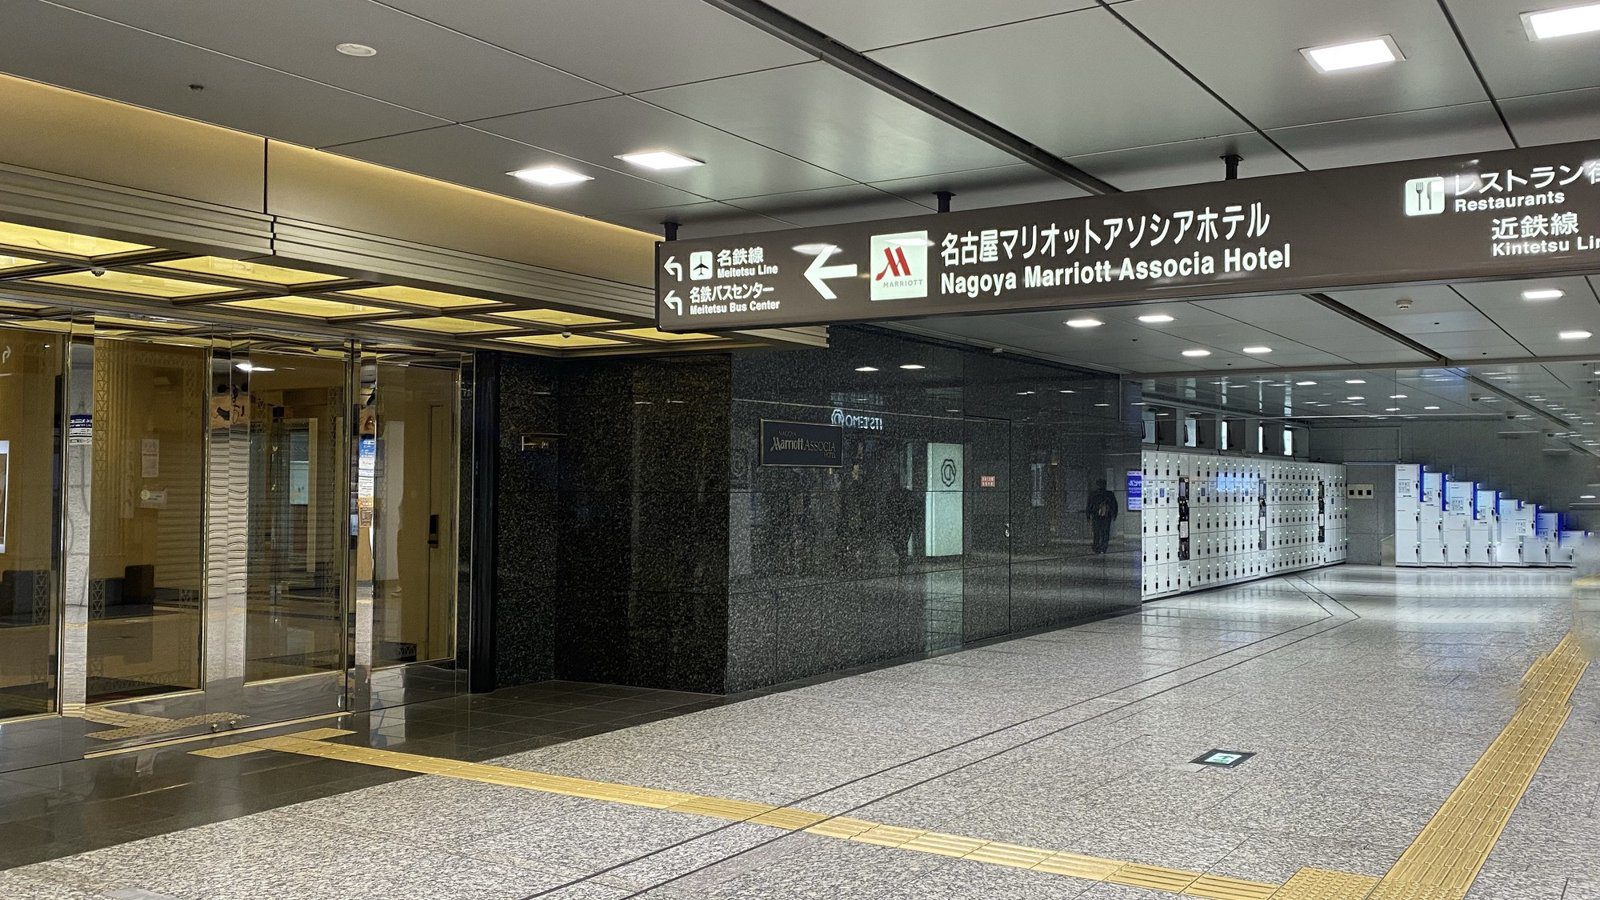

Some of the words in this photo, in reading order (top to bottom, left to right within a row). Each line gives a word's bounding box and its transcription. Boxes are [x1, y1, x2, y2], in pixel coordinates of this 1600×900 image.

[1454, 191, 1565, 213] Restaurants
[940, 202, 1270, 266] 名古屋マリオットアソシアホテル
[1491, 212, 1580, 241] 近鉄線
[717, 246, 764, 267] 名鉄線
[1492, 240, 1570, 257] Kintetsu
[717, 267, 756, 279] Meitetsu
[757, 264, 779, 276] Line
[940, 268, 1017, 298] Nagoya
[1023, 260, 1112, 289] Marriott
[1118, 251, 1216, 281] Associa
[1224, 243, 1291, 273] Hotel
[689, 282, 775, 304] 名鉄バスセンター
[883, 279, 923, 288] MARRIOTT
[689, 304, 727, 316] Meitetsu
[729, 302, 747, 313] Bus
[749, 300, 780, 312] Center
